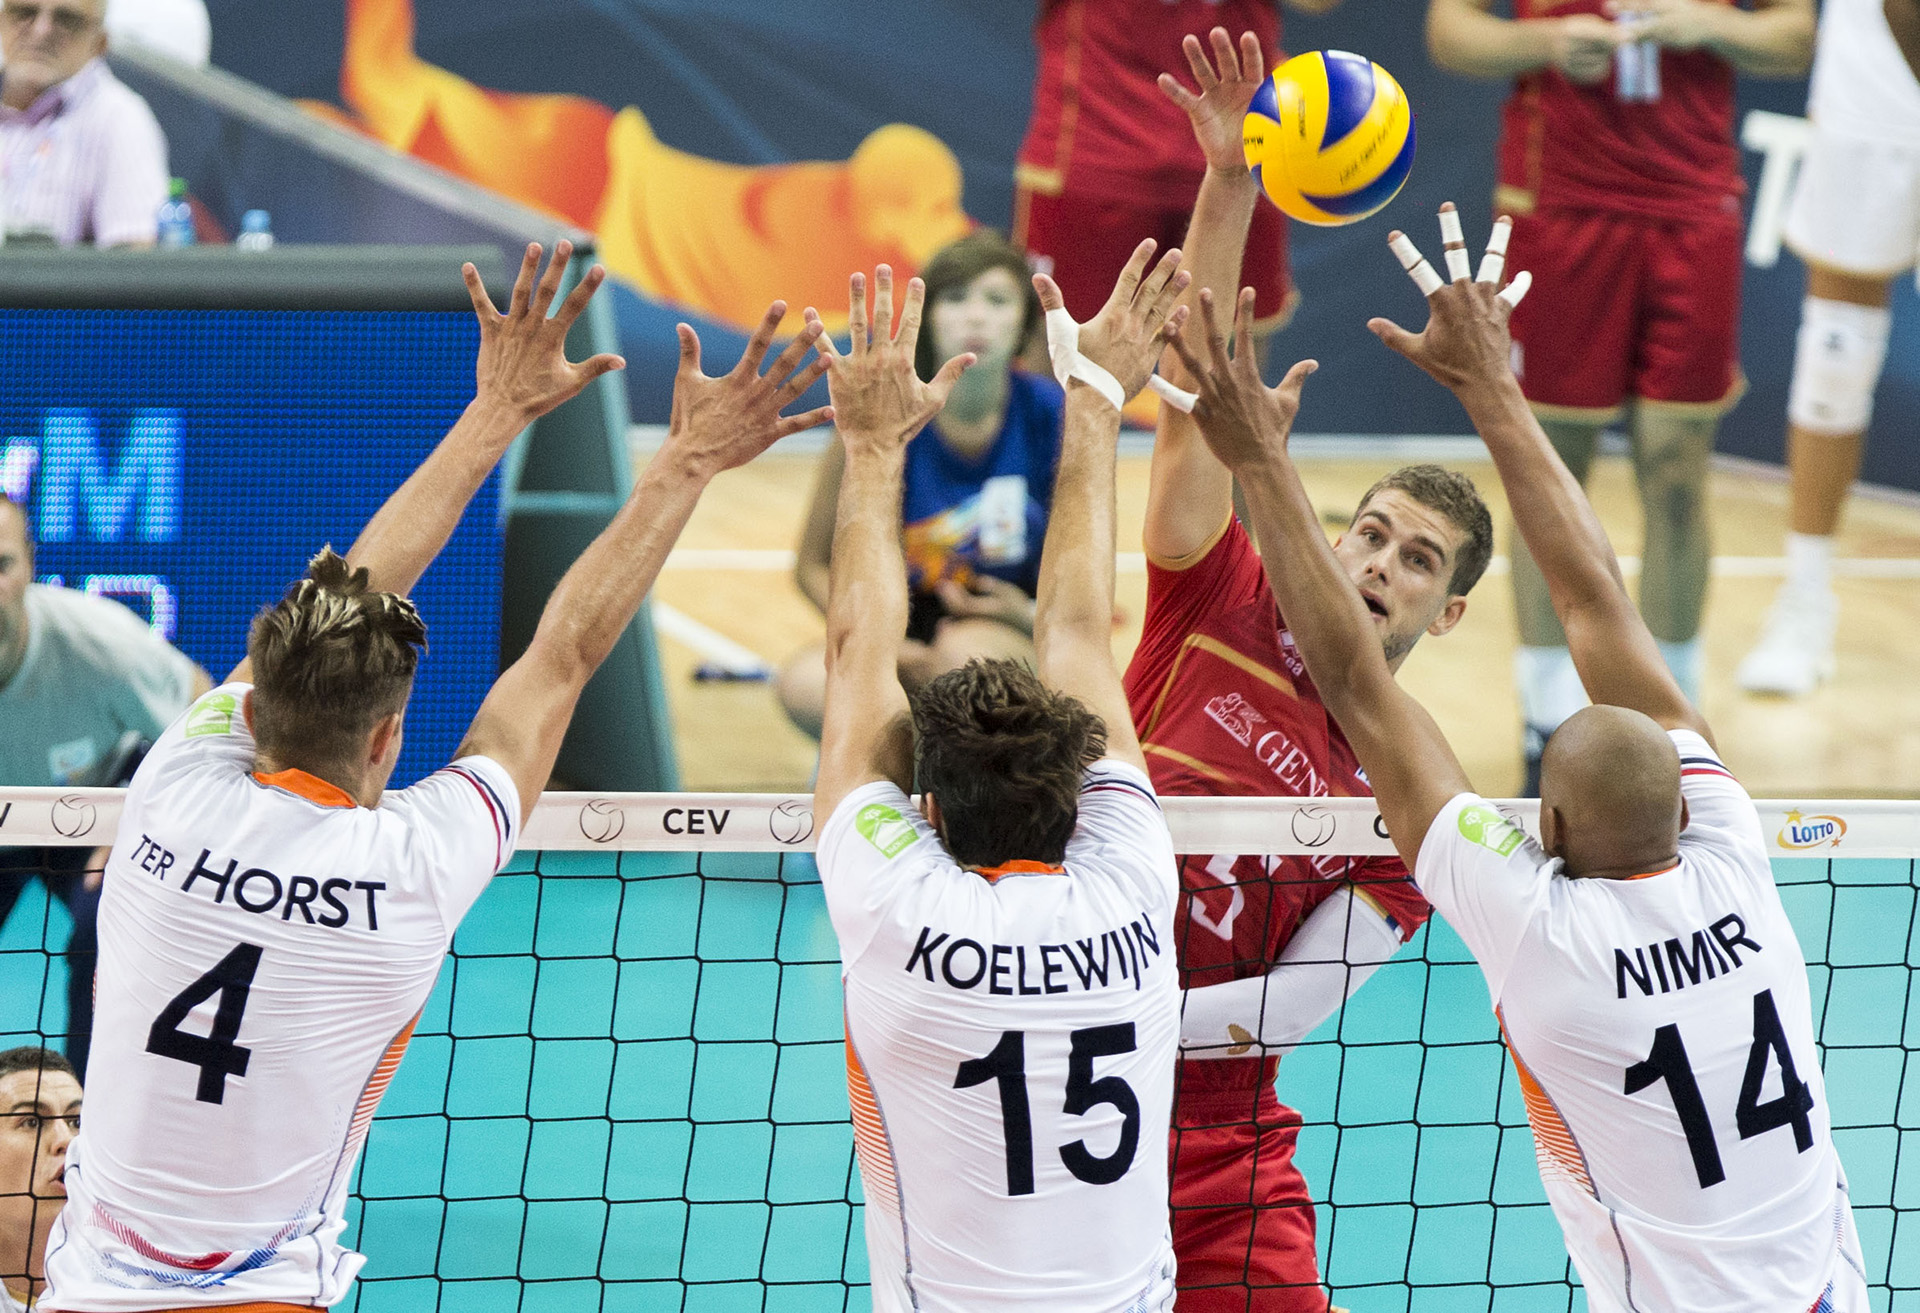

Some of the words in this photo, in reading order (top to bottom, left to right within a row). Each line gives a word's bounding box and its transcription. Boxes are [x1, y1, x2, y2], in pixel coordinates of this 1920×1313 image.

[662, 808, 731, 835] CEV
[1791, 822, 1834, 843] LOTTO
[130, 834, 175, 881] TER
[180, 848, 387, 932] HORST
[905, 912, 1160, 996] KOELEWIJN
[1614, 912, 1763, 999] NIMIR
[145, 942, 264, 1105] 4
[952, 1021, 1141, 1197] 15
[1624, 988, 1815, 1189] 14
